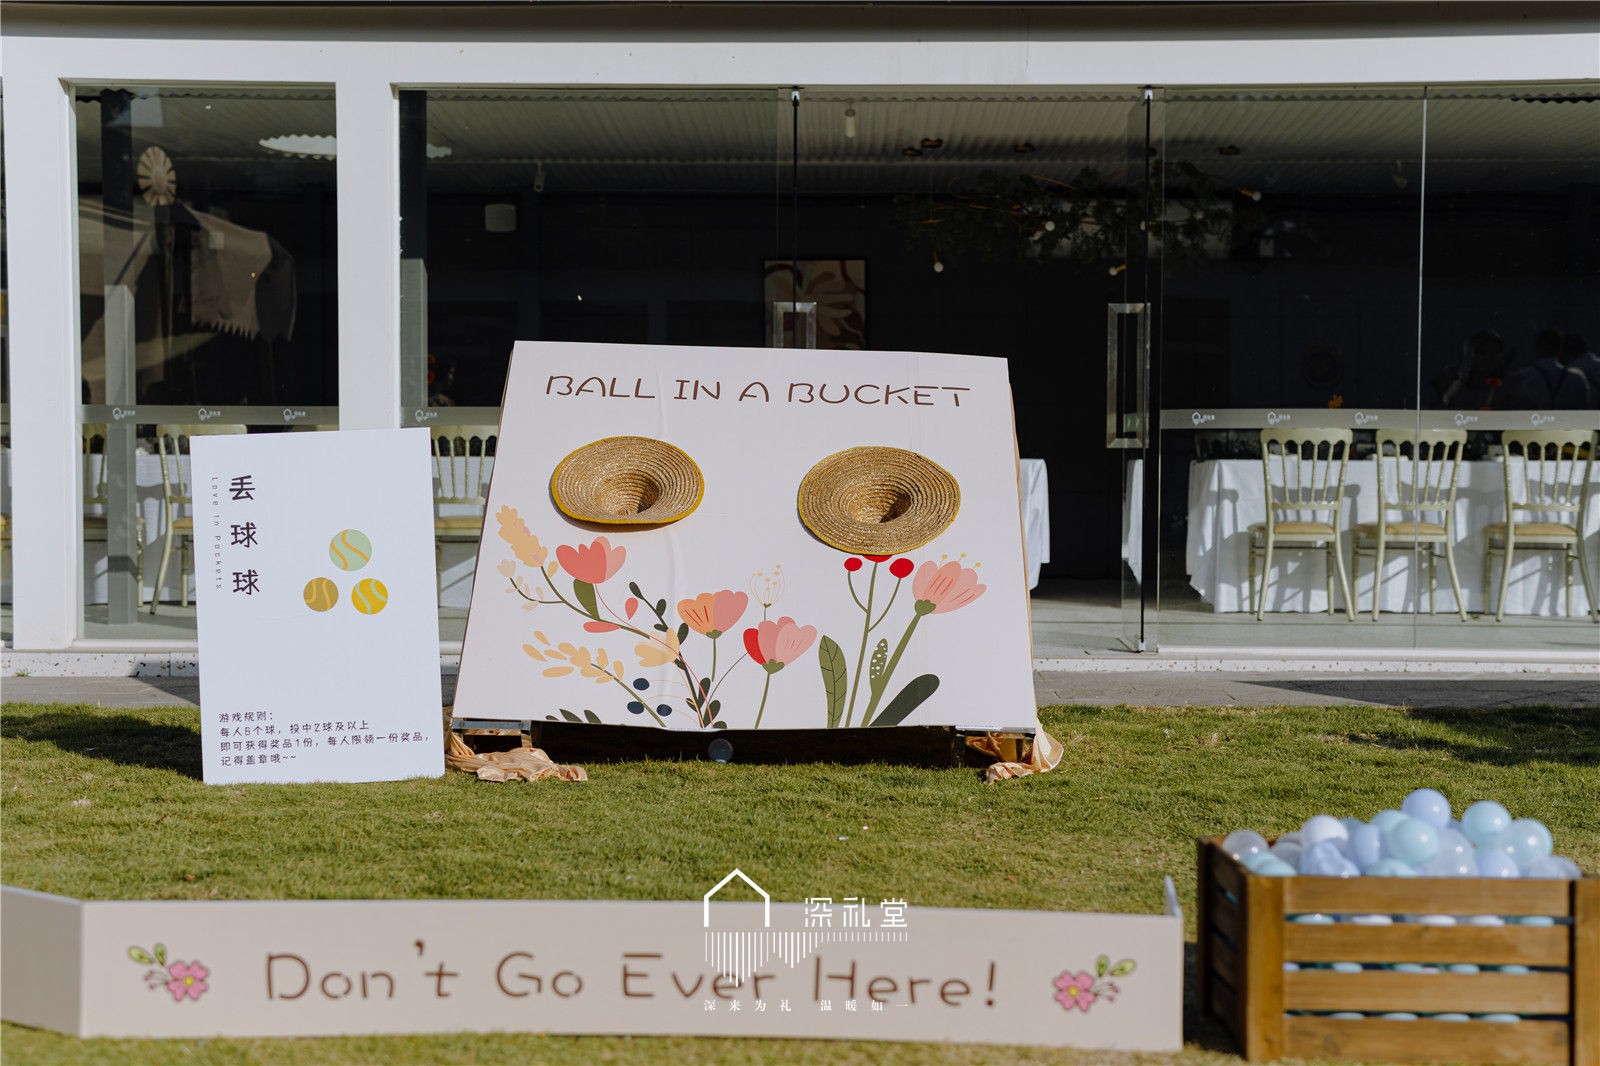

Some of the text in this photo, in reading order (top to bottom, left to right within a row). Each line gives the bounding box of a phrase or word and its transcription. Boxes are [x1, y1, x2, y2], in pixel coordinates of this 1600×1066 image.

[546, 376, 970, 407] BALL IN A BUCKET
[228, 474, 261, 596] 丢球球
[265, 939, 997, 1008] Don't Go Ever Here!
